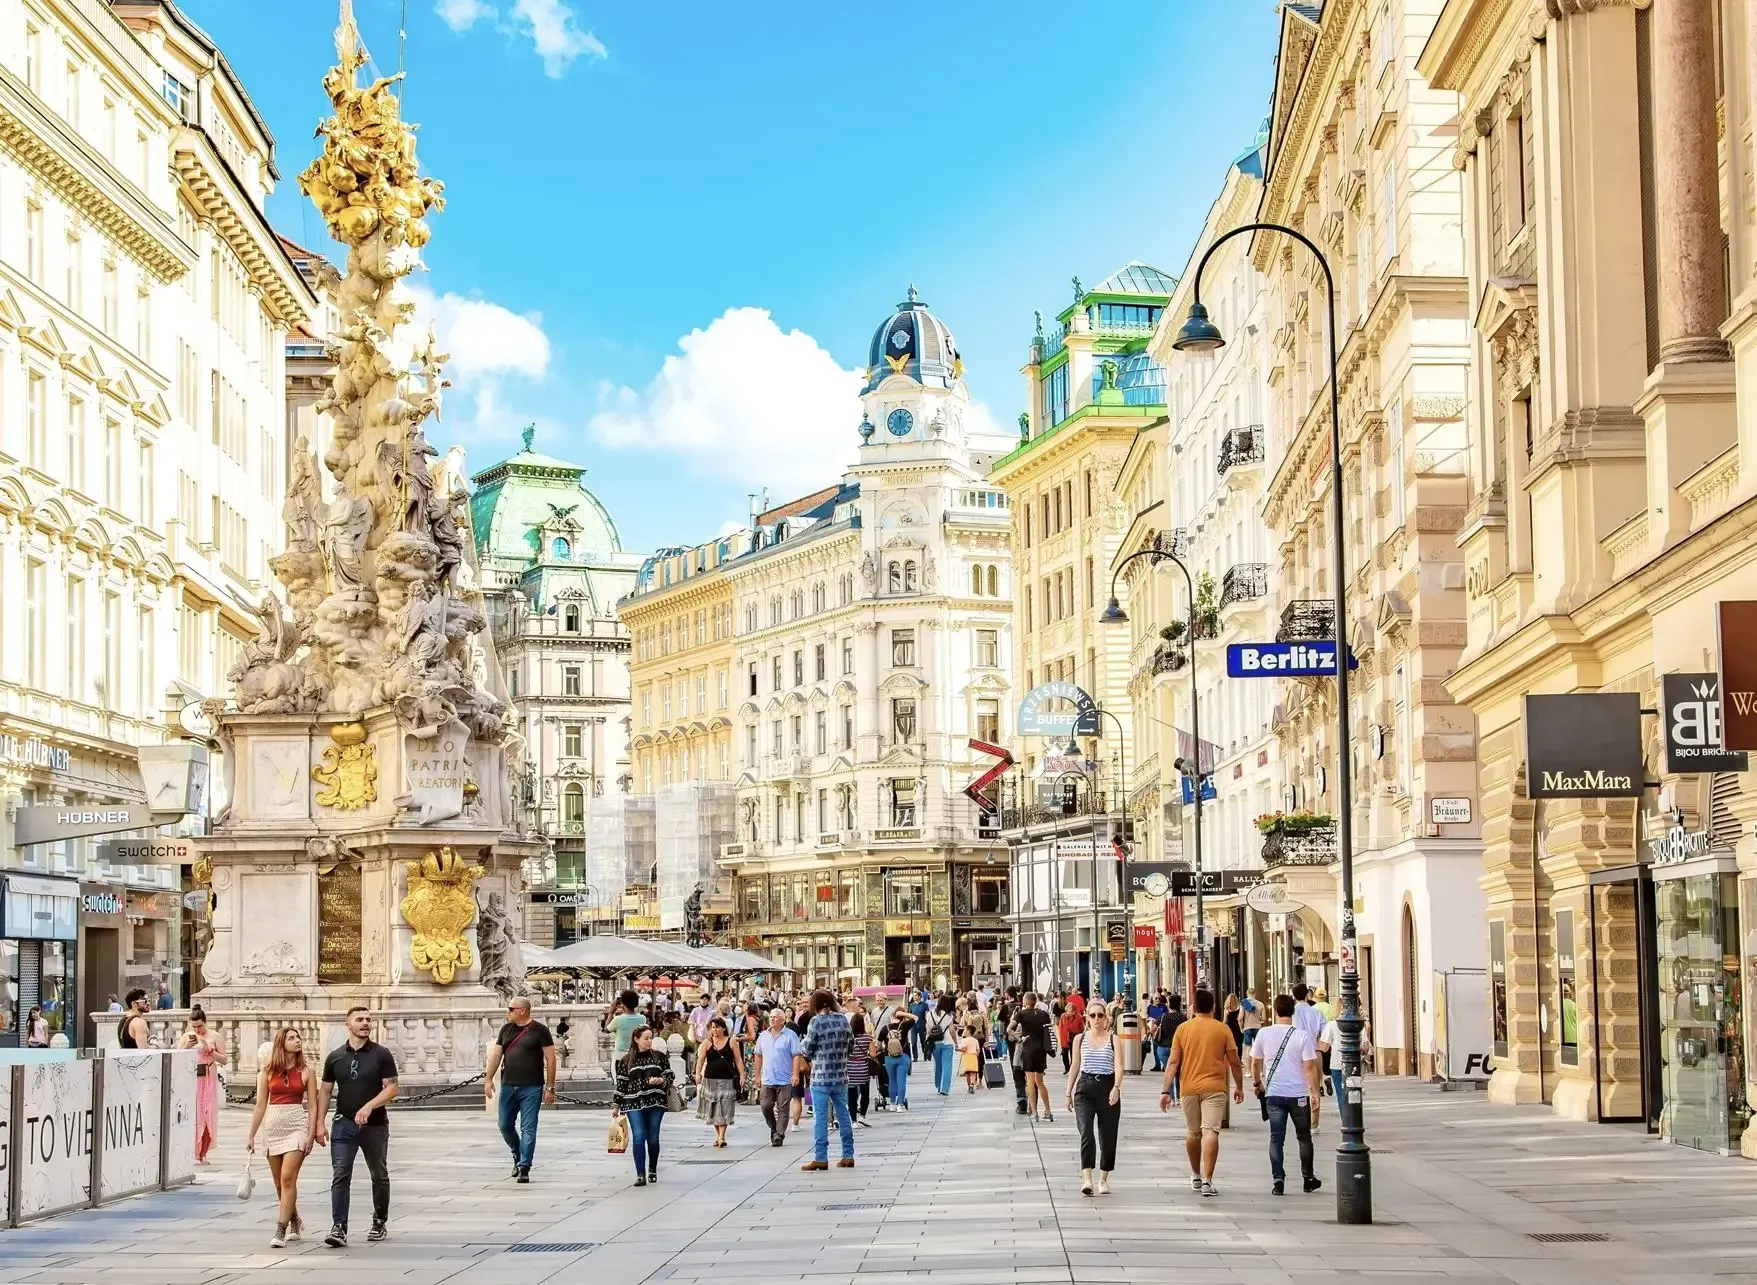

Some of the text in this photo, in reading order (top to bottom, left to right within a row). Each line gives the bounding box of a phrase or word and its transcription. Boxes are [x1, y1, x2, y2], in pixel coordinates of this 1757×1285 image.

[1241, 645, 1335, 670] Berlitz
[24, 737, 70, 770] HÜBNER
[1675, 749, 1700, 758] BIJOU
[412, 759, 458, 770] PATRI
[1541, 770, 1632, 791] MaxMara
[1434, 805, 1469, 816] Bräuner-
[57, 811, 130, 825] HÜBNER
[117, 845, 176, 857] swatch
[1190, 875, 1214, 886] IWC
[82, 893, 117, 913] swatch
[27, 1115, 55, 1164] TO
